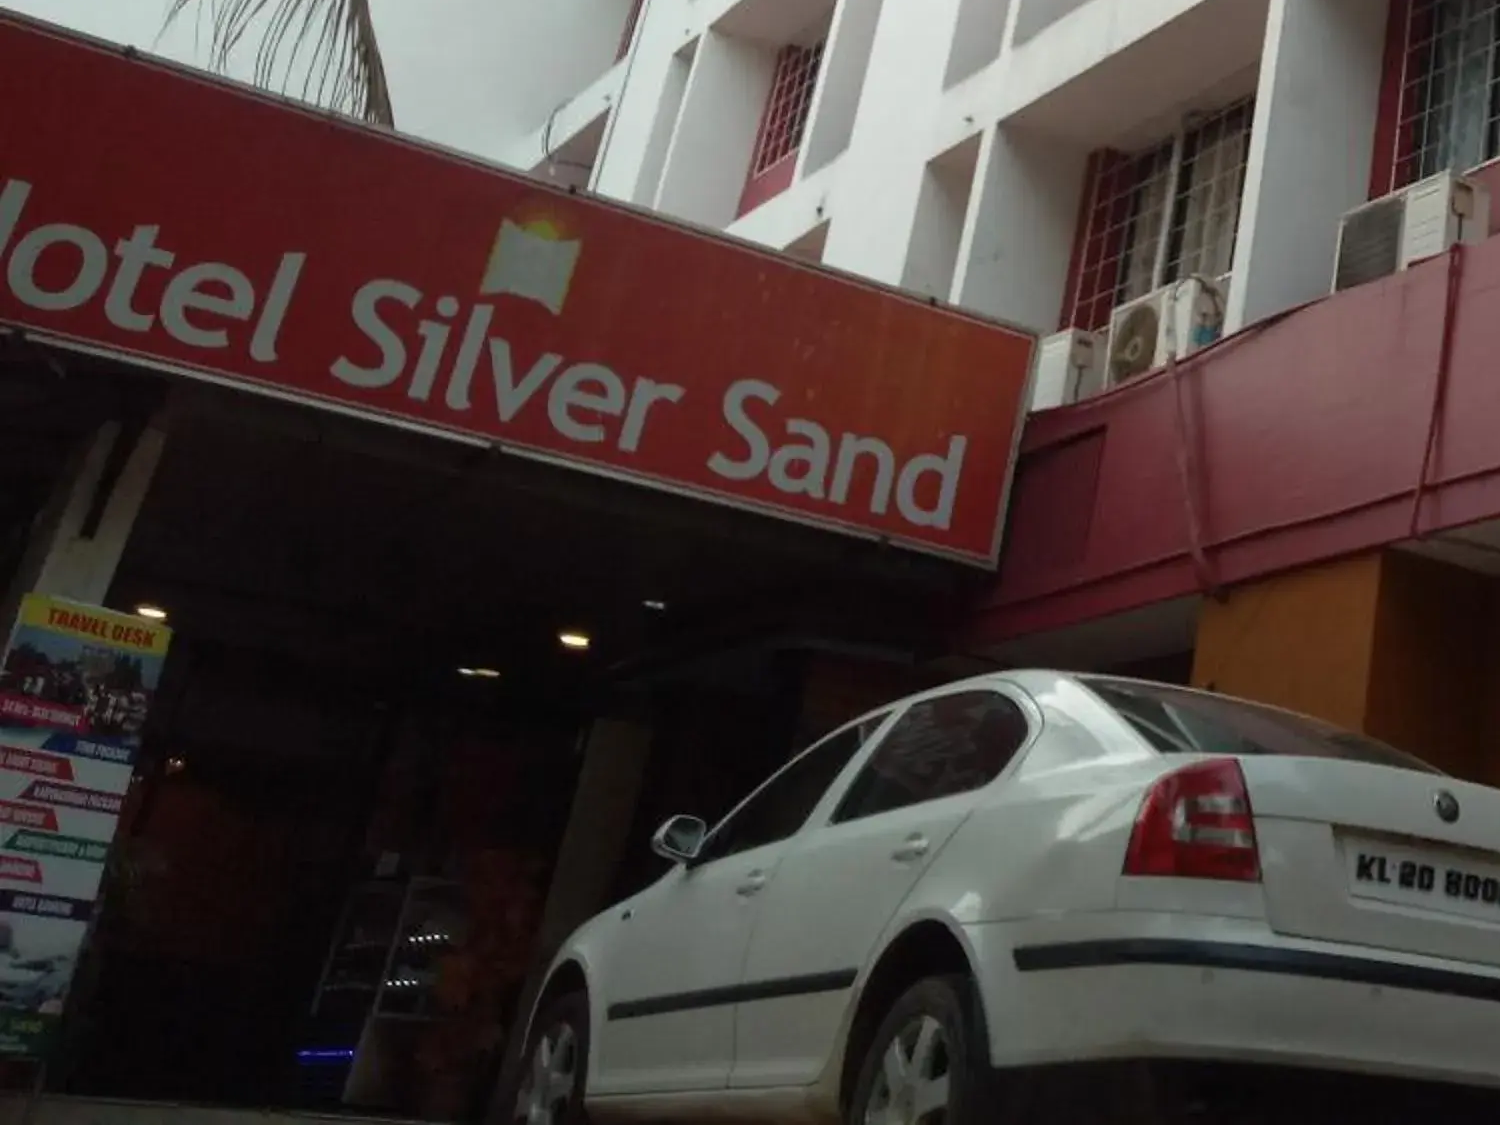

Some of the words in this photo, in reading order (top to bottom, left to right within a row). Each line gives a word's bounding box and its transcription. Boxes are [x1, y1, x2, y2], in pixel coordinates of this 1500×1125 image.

[330, 280, 685, 453] Silver
[707, 379, 968, 531] Sand
[48, 608, 108, 638] TRAVEL
[111, 624, 157, 648] DESK
[1356, 853, 1392, 885] KL
